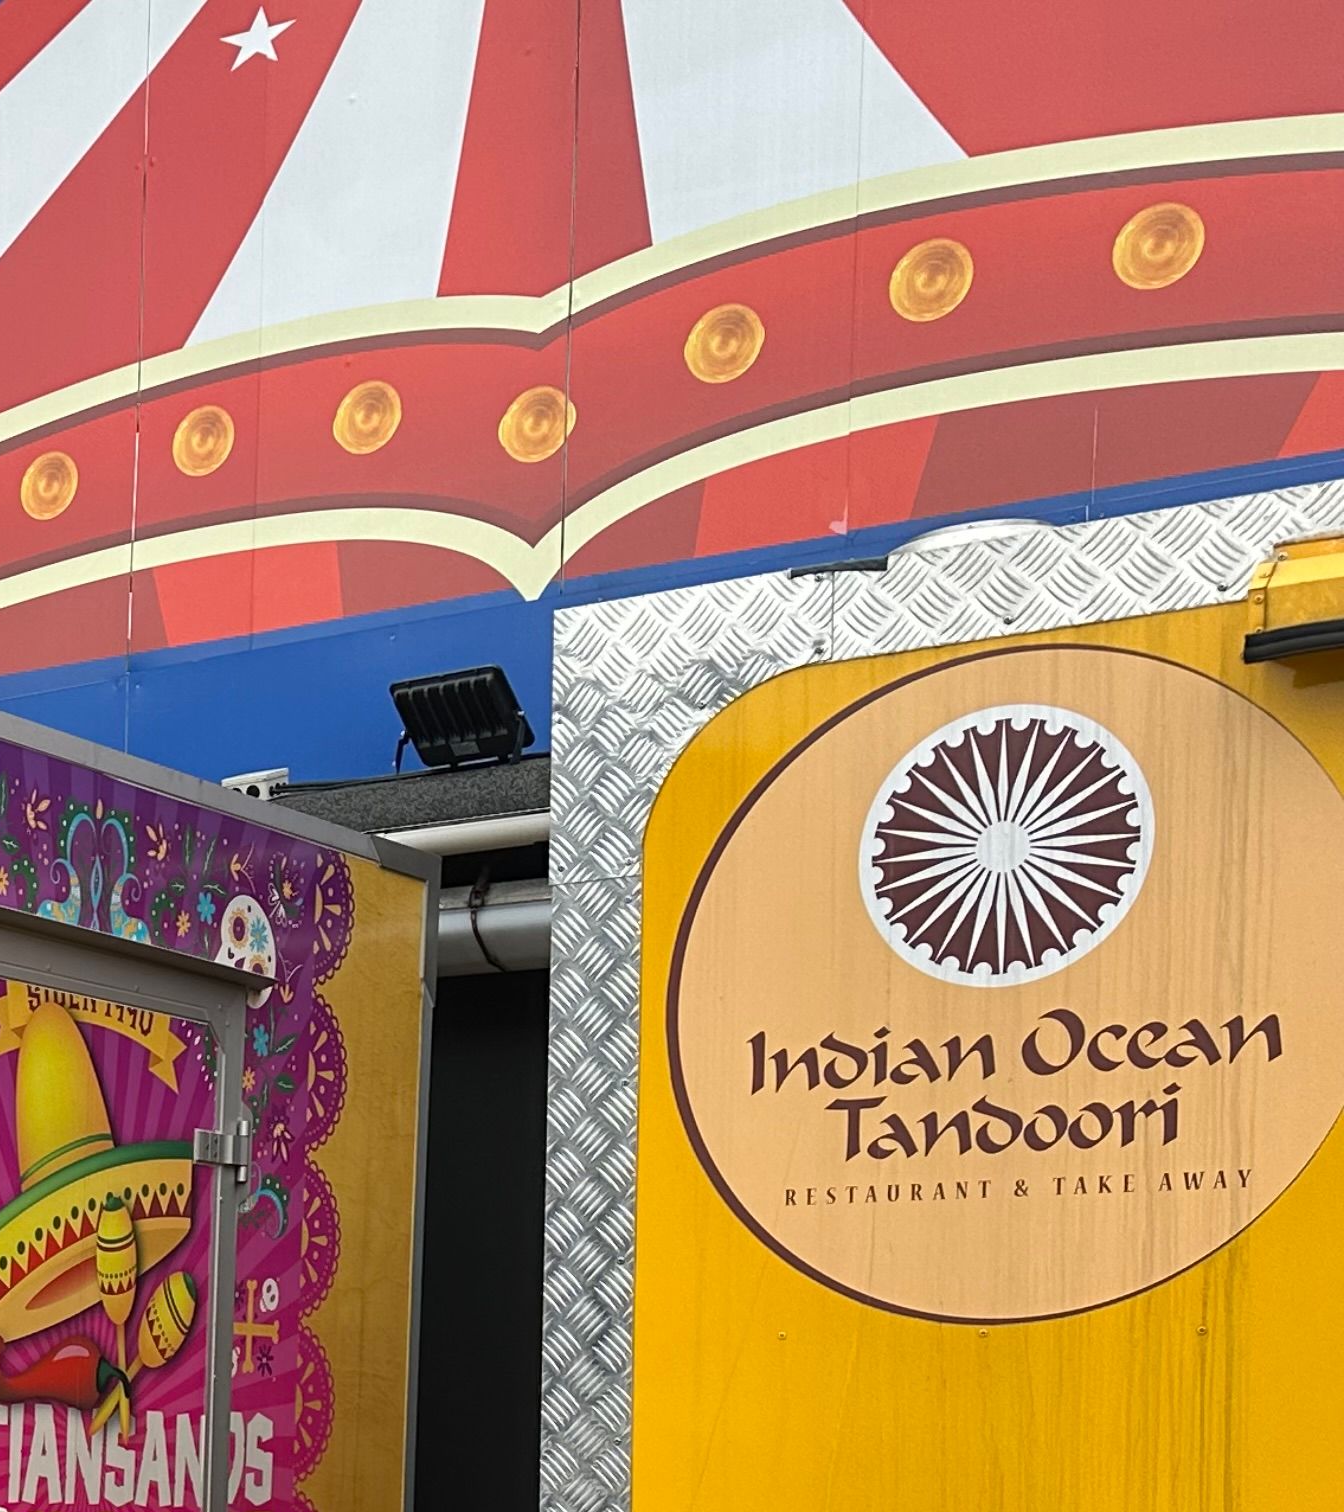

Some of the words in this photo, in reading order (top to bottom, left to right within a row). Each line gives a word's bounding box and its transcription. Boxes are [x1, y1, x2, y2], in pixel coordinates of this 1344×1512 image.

[746, 1026, 996, 1097] Indian
[1020, 1008, 1284, 1077] Ocean
[824, 1082, 1181, 1163] Tandoori
[785, 1179, 994, 1207] RESTAURANT
[1013, 1178, 1031, 1198] &
[1053, 1172, 1136, 1196] TAKE
[1158, 1168, 1254, 1192] AWAY
